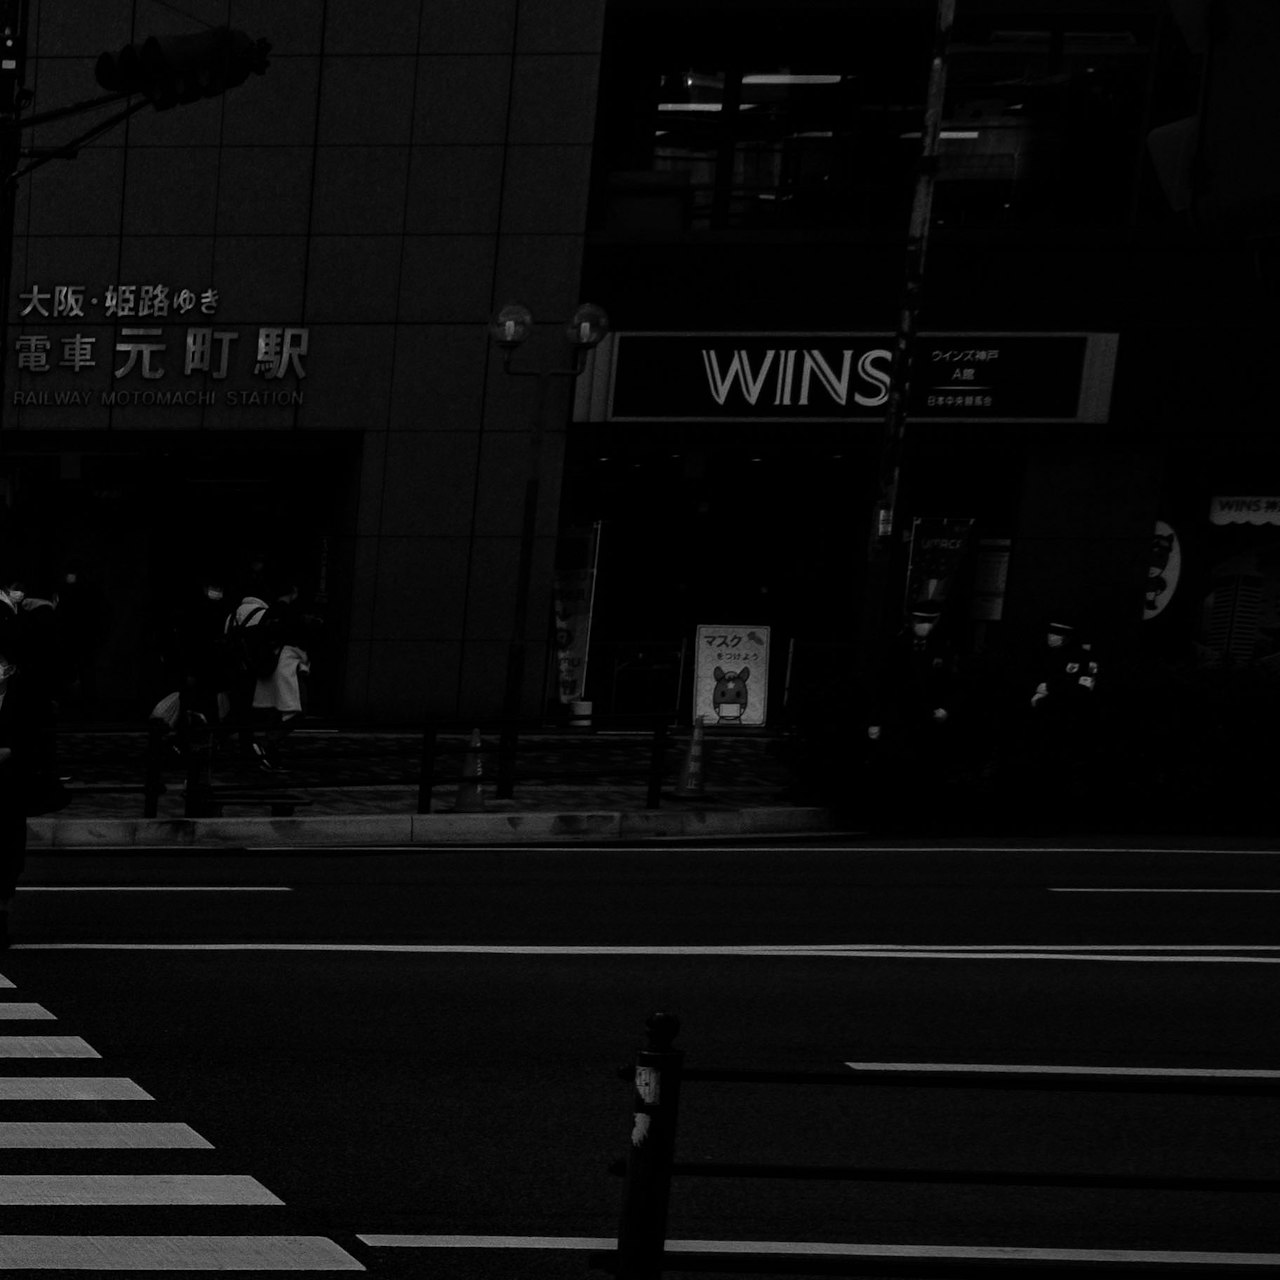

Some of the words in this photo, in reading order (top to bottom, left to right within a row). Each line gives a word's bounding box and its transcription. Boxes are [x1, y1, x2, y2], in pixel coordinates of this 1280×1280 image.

[114, 326, 309, 380] 元町駅
[702, 348, 893, 407] WINS
[13, 391, 92, 407] RAILWAY
[100, 391, 216, 407] MOTOMACHI
[225, 391, 304, 407] STATION
[704, 634, 743, 648] マスク
[717, 652, 759, 661] をつけよう
